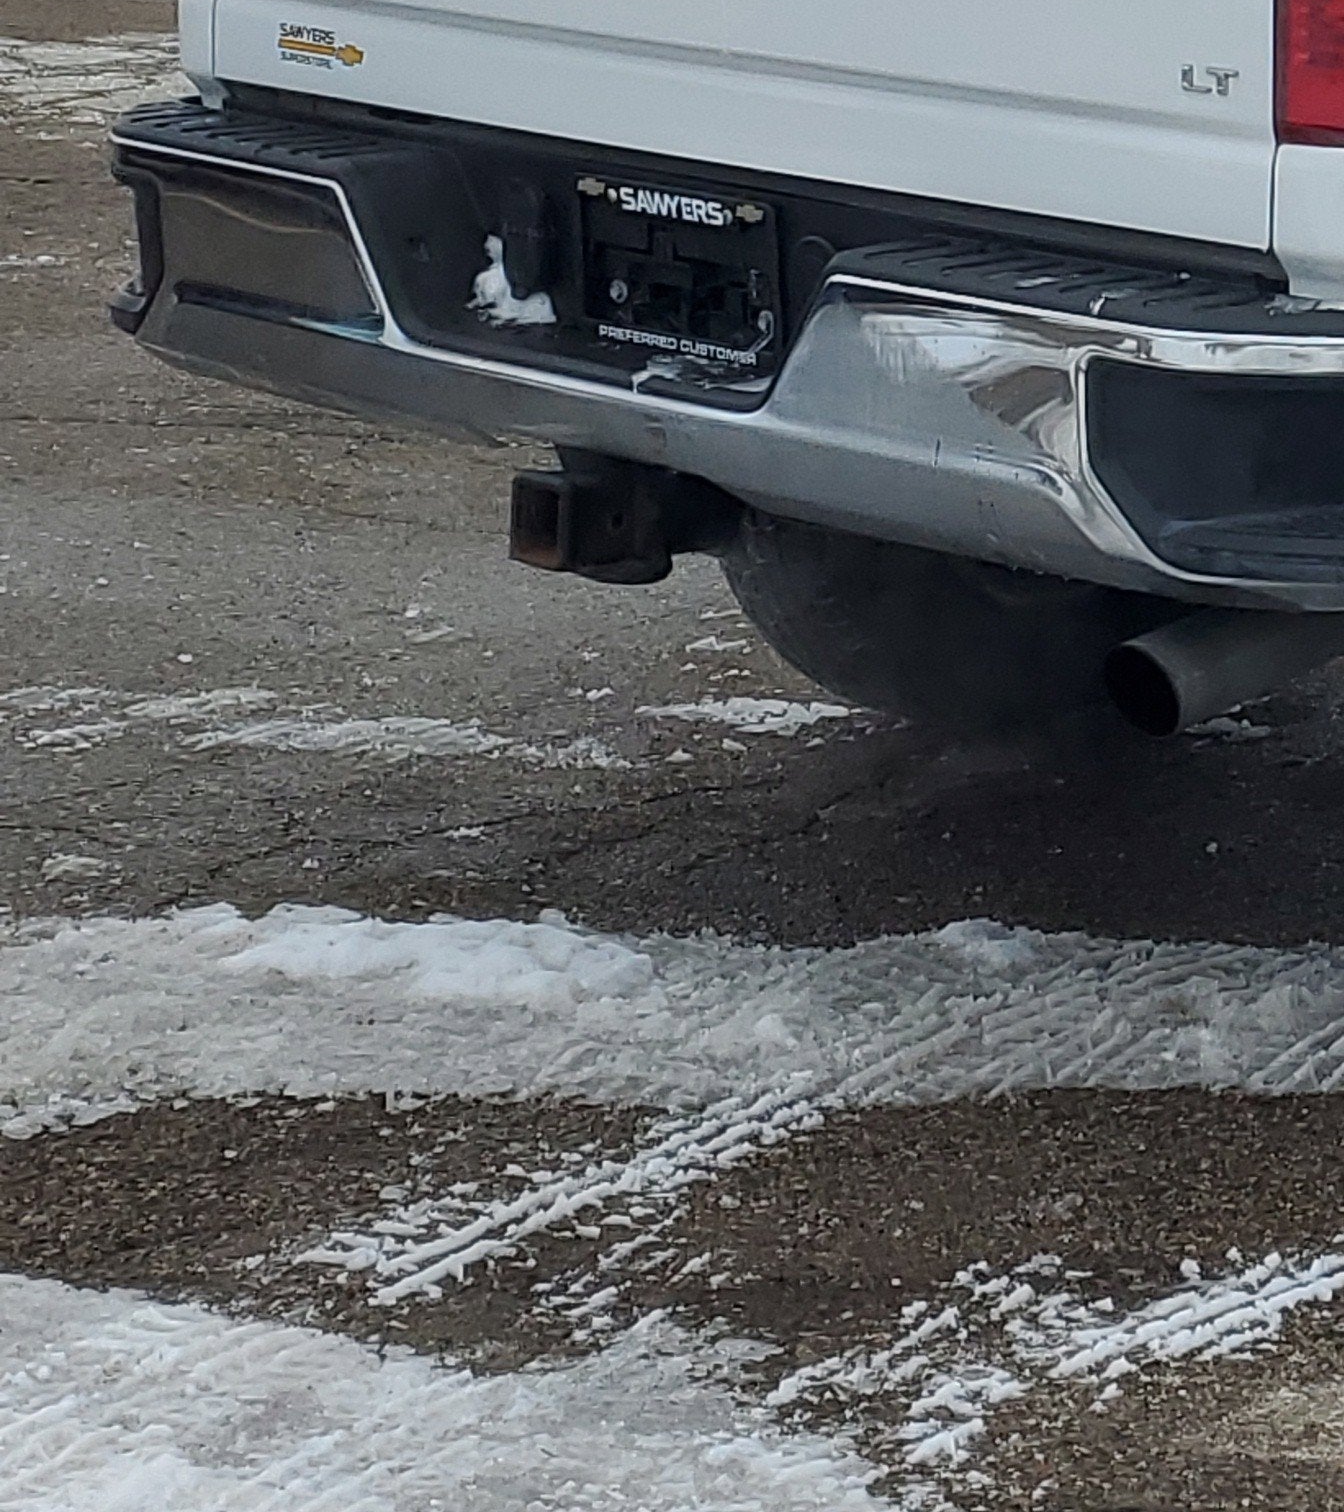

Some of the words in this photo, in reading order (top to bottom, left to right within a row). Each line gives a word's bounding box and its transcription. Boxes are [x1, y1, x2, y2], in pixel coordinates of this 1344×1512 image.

[279, 22, 336, 45] SAWYERS
[1181, 63, 1240, 96] LT
[619, 186, 725, 226] SAWYERS
[598, 324, 678, 350] PREFERRED
[679, 338, 758, 366] CUSTOMER
